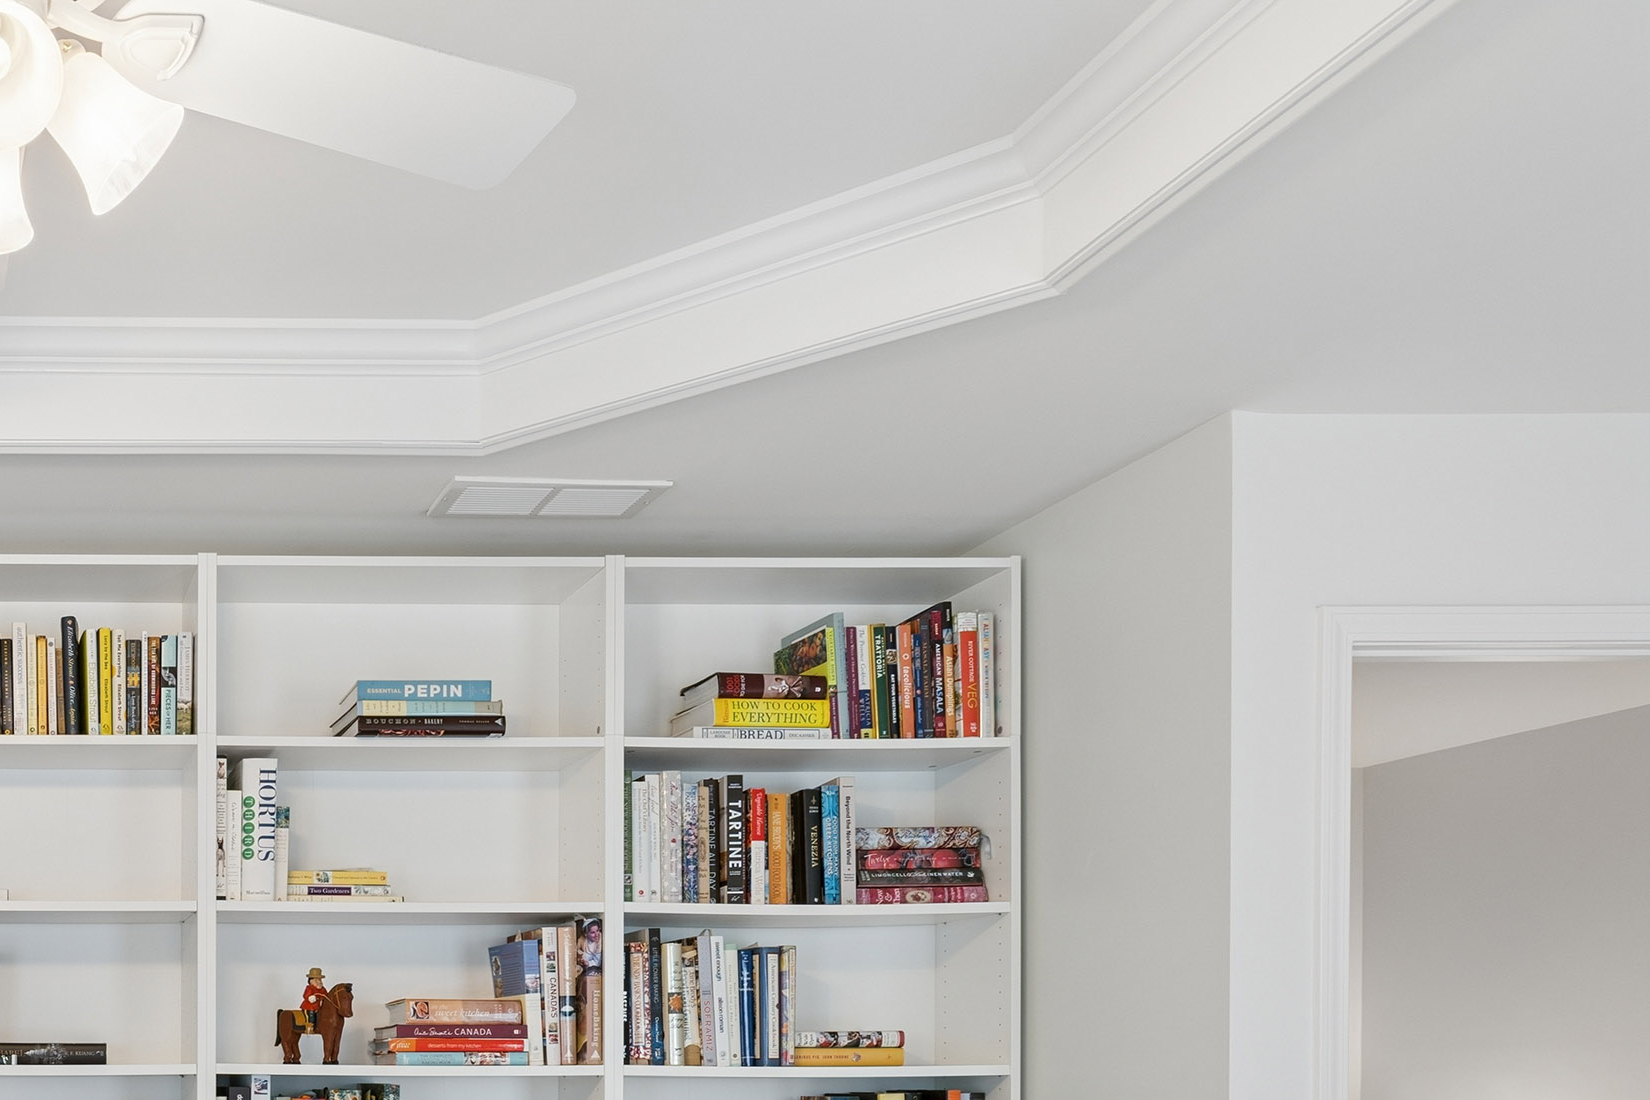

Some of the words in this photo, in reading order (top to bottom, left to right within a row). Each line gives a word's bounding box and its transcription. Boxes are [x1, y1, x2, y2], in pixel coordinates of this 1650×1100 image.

[404, 685, 462, 697] PEPIN
[732, 701, 759, 709] HOW
[784, 701, 817, 711] COOK
[732, 712, 817, 724] EVERYTHING
[740, 730, 784, 739] BREAD
[243, 796, 256, 860] THIRD
[258, 768, 277, 861] HORTUS
[729, 800, 742, 868] TARTINE
[810, 825, 819, 868] VENEZIA
[704, 1000, 713, 1052] SOFRAMIZ
